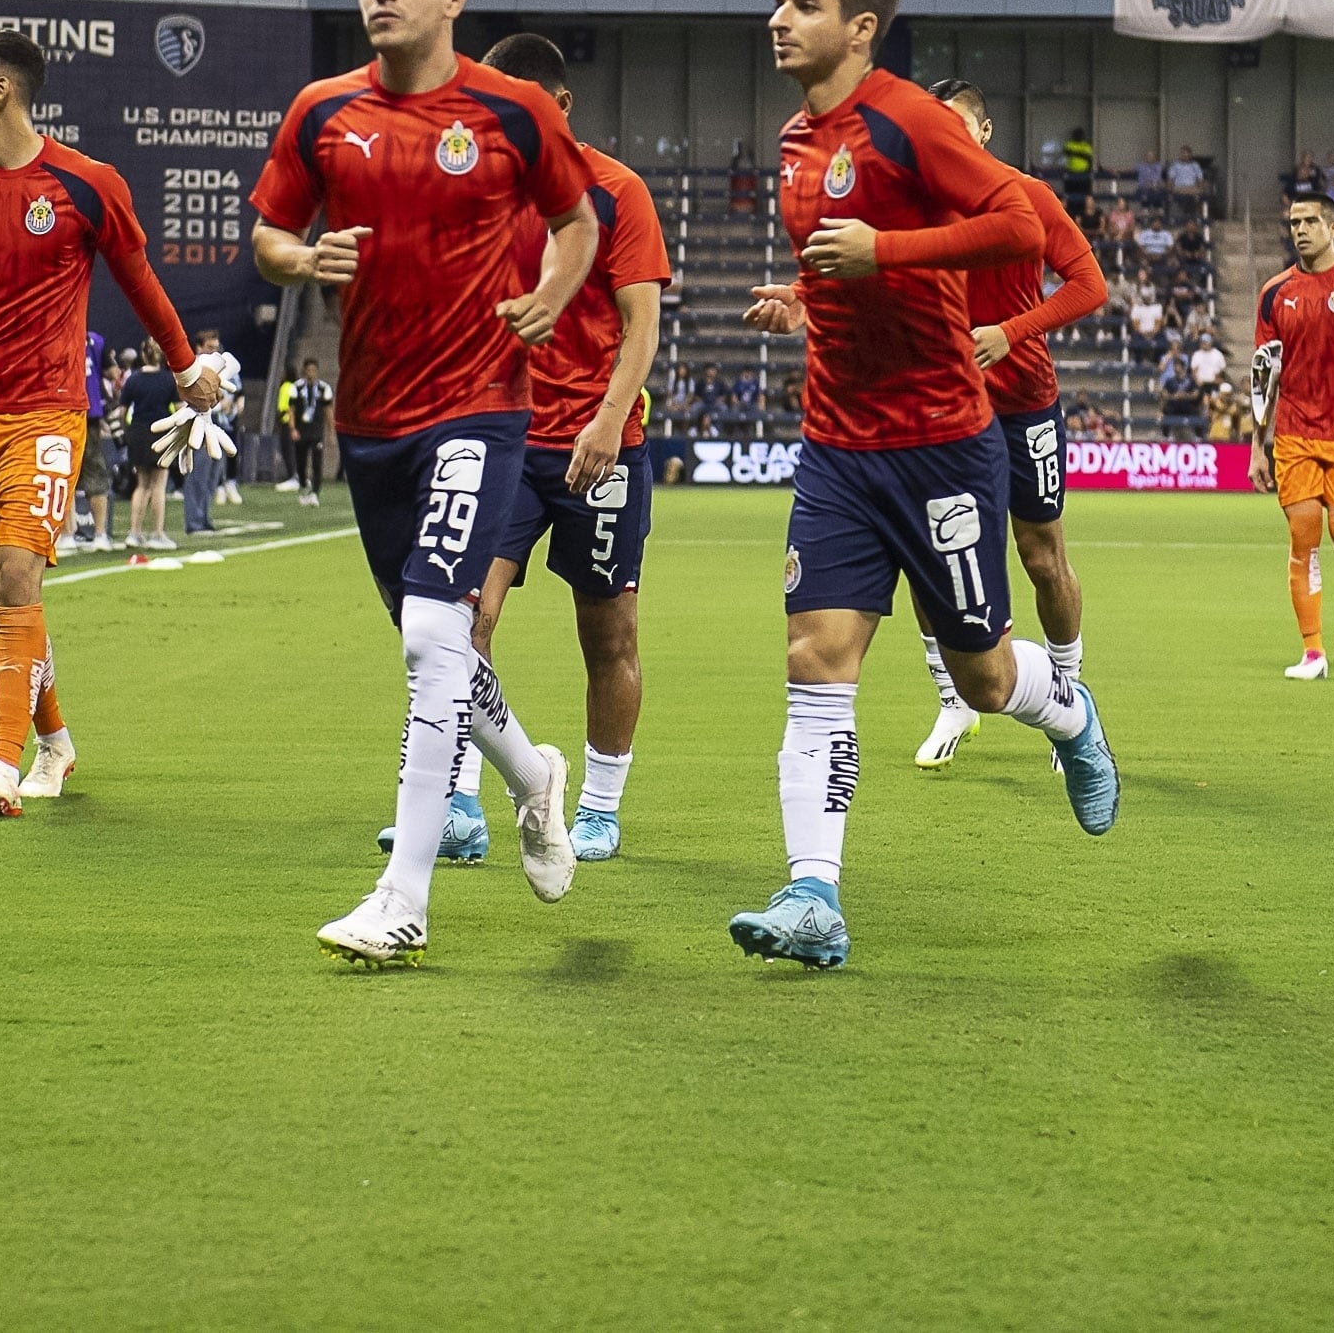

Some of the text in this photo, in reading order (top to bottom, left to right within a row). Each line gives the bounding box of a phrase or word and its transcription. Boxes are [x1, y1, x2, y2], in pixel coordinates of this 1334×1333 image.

[31, 102, 63, 122] UP
[123, 106, 282, 128] U.S. OPEN CUP
[136, 127, 269, 149] CHAMPIONS
[164, 168, 241, 190] 2004
[164, 193, 241, 216] 2012
[163, 244, 240, 265] 2017
[731, 460, 796, 483] CUP
[1066, 443, 1217, 474] ODYARMOR
[1035, 454, 1060, 497] 18
[30, 475, 68, 521] 30
[418, 491, 478, 553] 29
[591, 513, 617, 561] 5
[945, 548, 985, 610] 11
[824, 731, 861, 813] PERDURA
